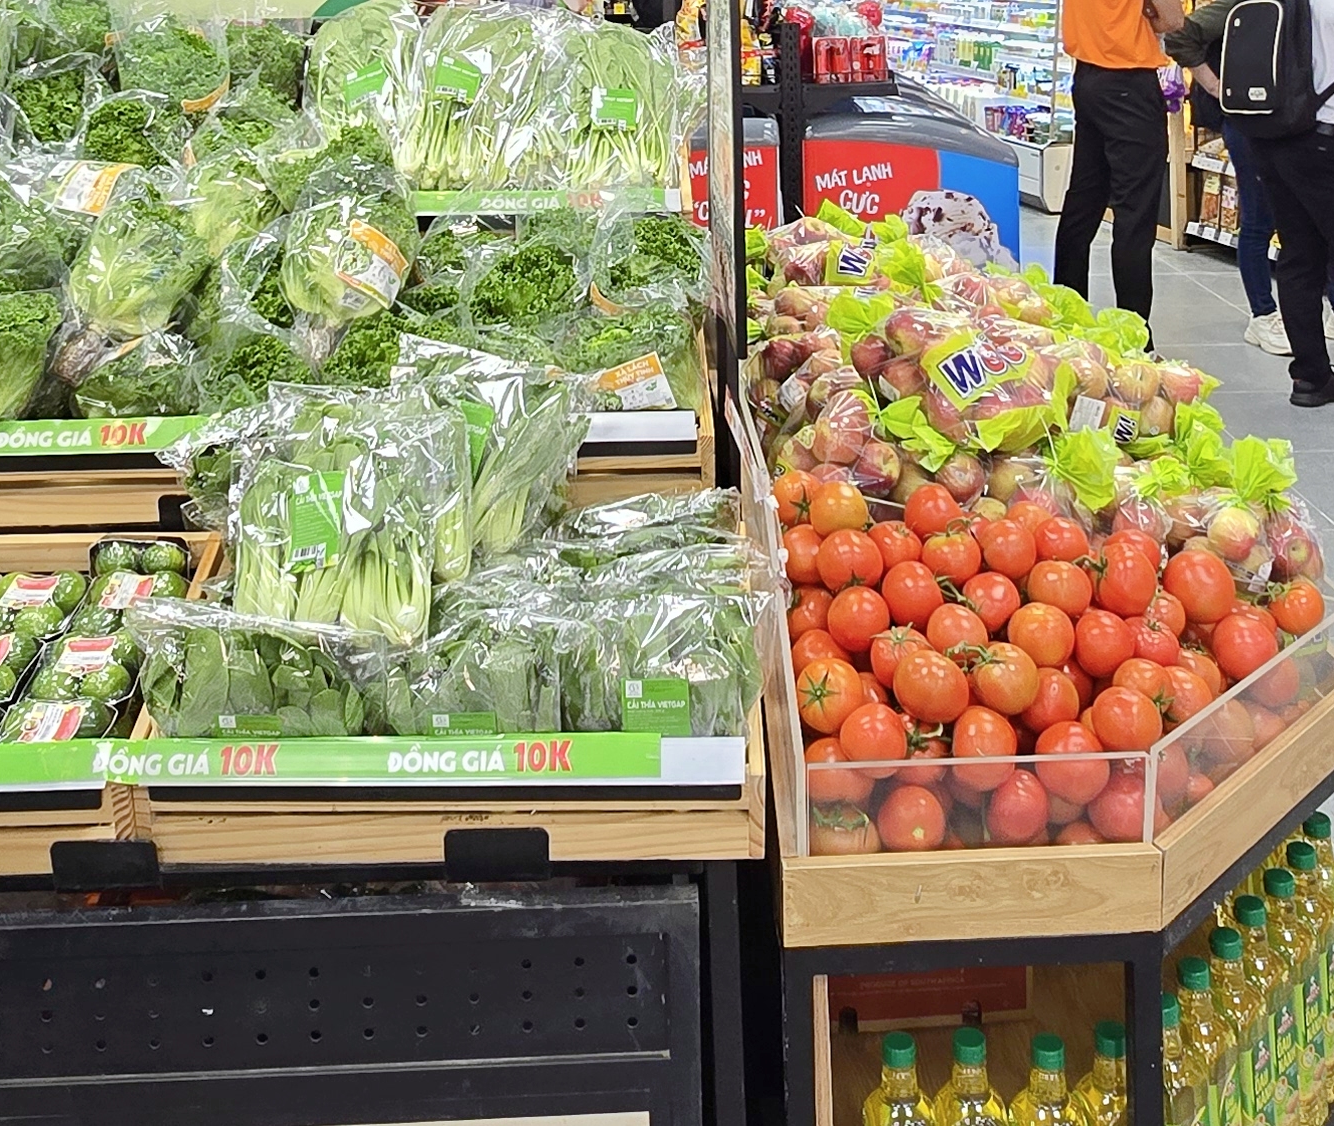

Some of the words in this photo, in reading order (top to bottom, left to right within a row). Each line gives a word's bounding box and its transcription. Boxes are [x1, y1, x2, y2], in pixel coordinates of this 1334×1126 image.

[815, 168, 846, 192] MÁT
[853, 161, 893, 189] LẠNH
[57, 424, 92, 447] GIÁ
[99, 421, 148, 446] 10K
[657, 699, 686, 709] VIETGAP
[92, 740, 164, 776] ĐỒNG
[167, 746, 210, 775] GIÁ
[220, 743, 280, 777] 10K
[387, 741, 457, 774] ĐỒNG
[462, 744, 506, 773] GIÁ
[513, 739, 573, 773] 10K
